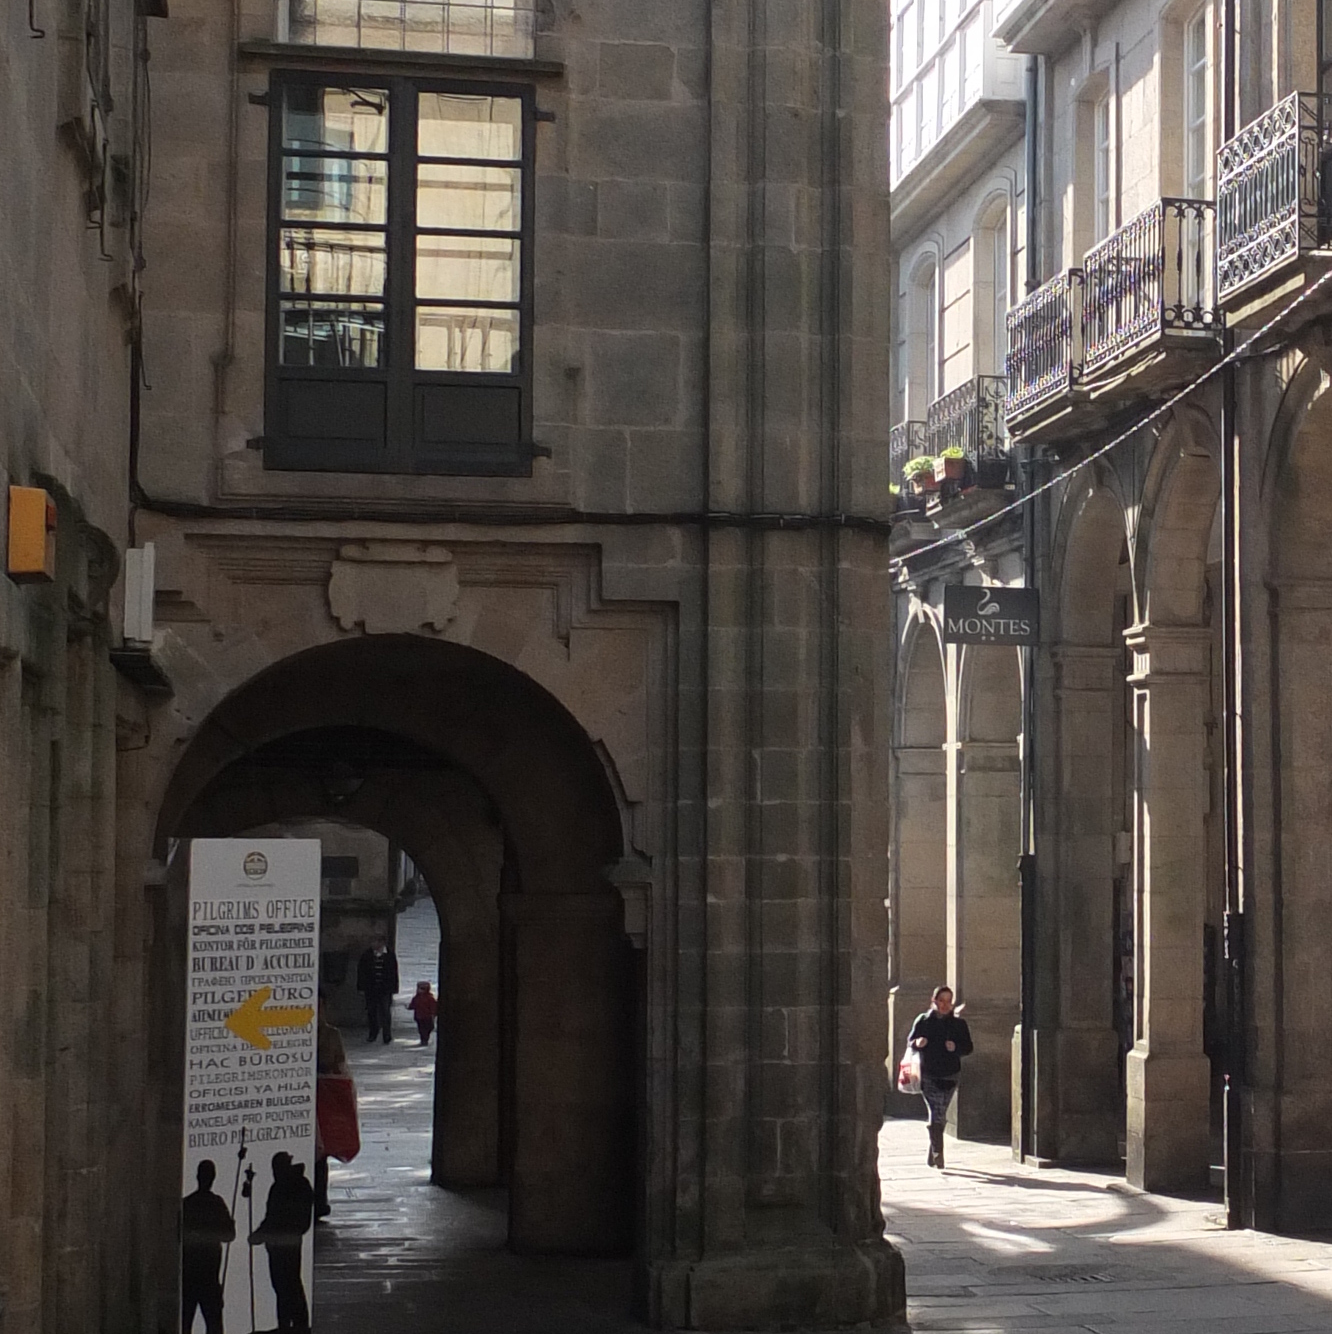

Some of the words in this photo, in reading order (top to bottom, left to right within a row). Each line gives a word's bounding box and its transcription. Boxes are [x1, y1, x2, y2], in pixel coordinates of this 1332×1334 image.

[947, 618, 1031, 636] MONTES
[192, 900, 260, 921] PILGRIMS
[266, 898, 315, 919] OFFICE
[192, 925, 230, 936] OFICINA
[234, 923, 256, 935] DOS
[192, 940, 234, 952] KONTOR
[236, 937, 257, 951] FÖR
[259, 937, 315, 950] PILGRIMER
[192, 956, 241, 973] BUREAU
[261, 953, 315, 970] ACCUEIL
[190, 1044, 237, 1054] OFICINA
[189, 1057, 231, 1069] HAC
[189, 1086, 248, 1098] OFICISI
[254, 1084, 273, 1094] YA
[277, 1081, 311, 1092] HIJA
[189, 1098, 263, 1114] ERROMESAREN
[242, 1113, 262, 1124] PRO
[189, 1131, 228, 1148] BIURO
